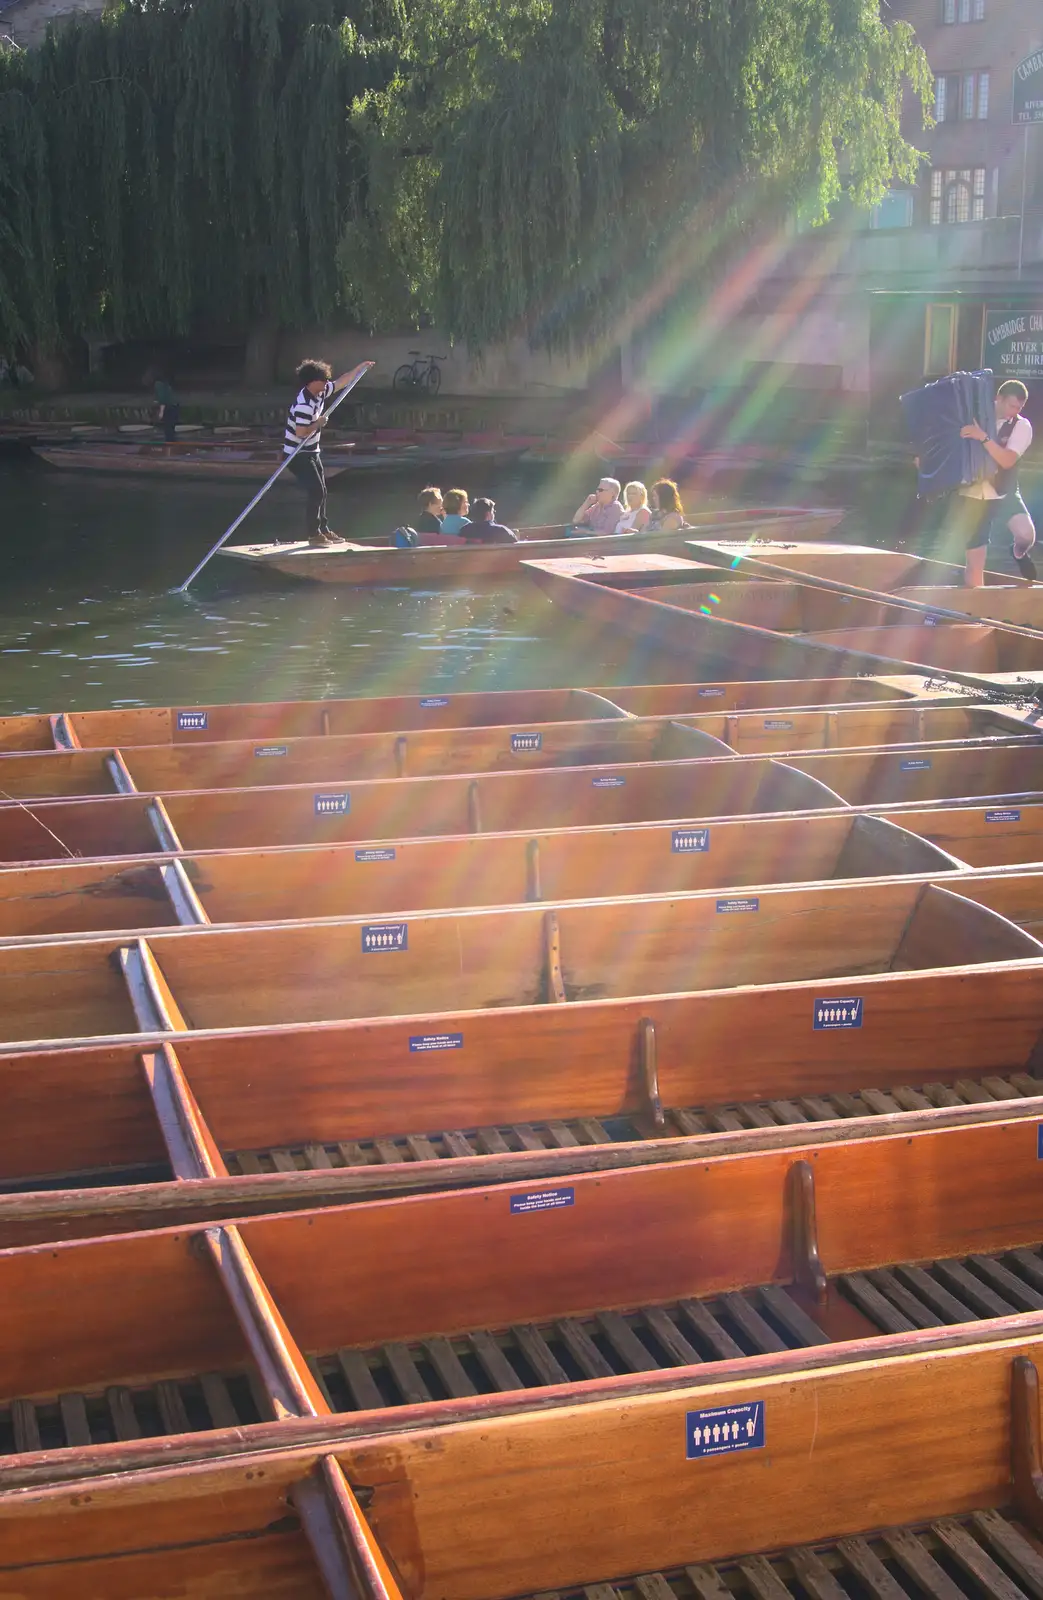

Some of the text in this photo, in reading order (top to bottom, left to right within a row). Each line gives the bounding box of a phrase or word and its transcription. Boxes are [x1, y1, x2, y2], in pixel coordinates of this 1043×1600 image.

[1017, 51, 1043, 81] CAMBR
[988, 316, 1027, 346] CAMBRIDGE
[1011, 341, 1037, 353] RIVER
[1000, 353, 1021, 365] SELF
[700, 1406, 752, 1418] Maximum Capacity
